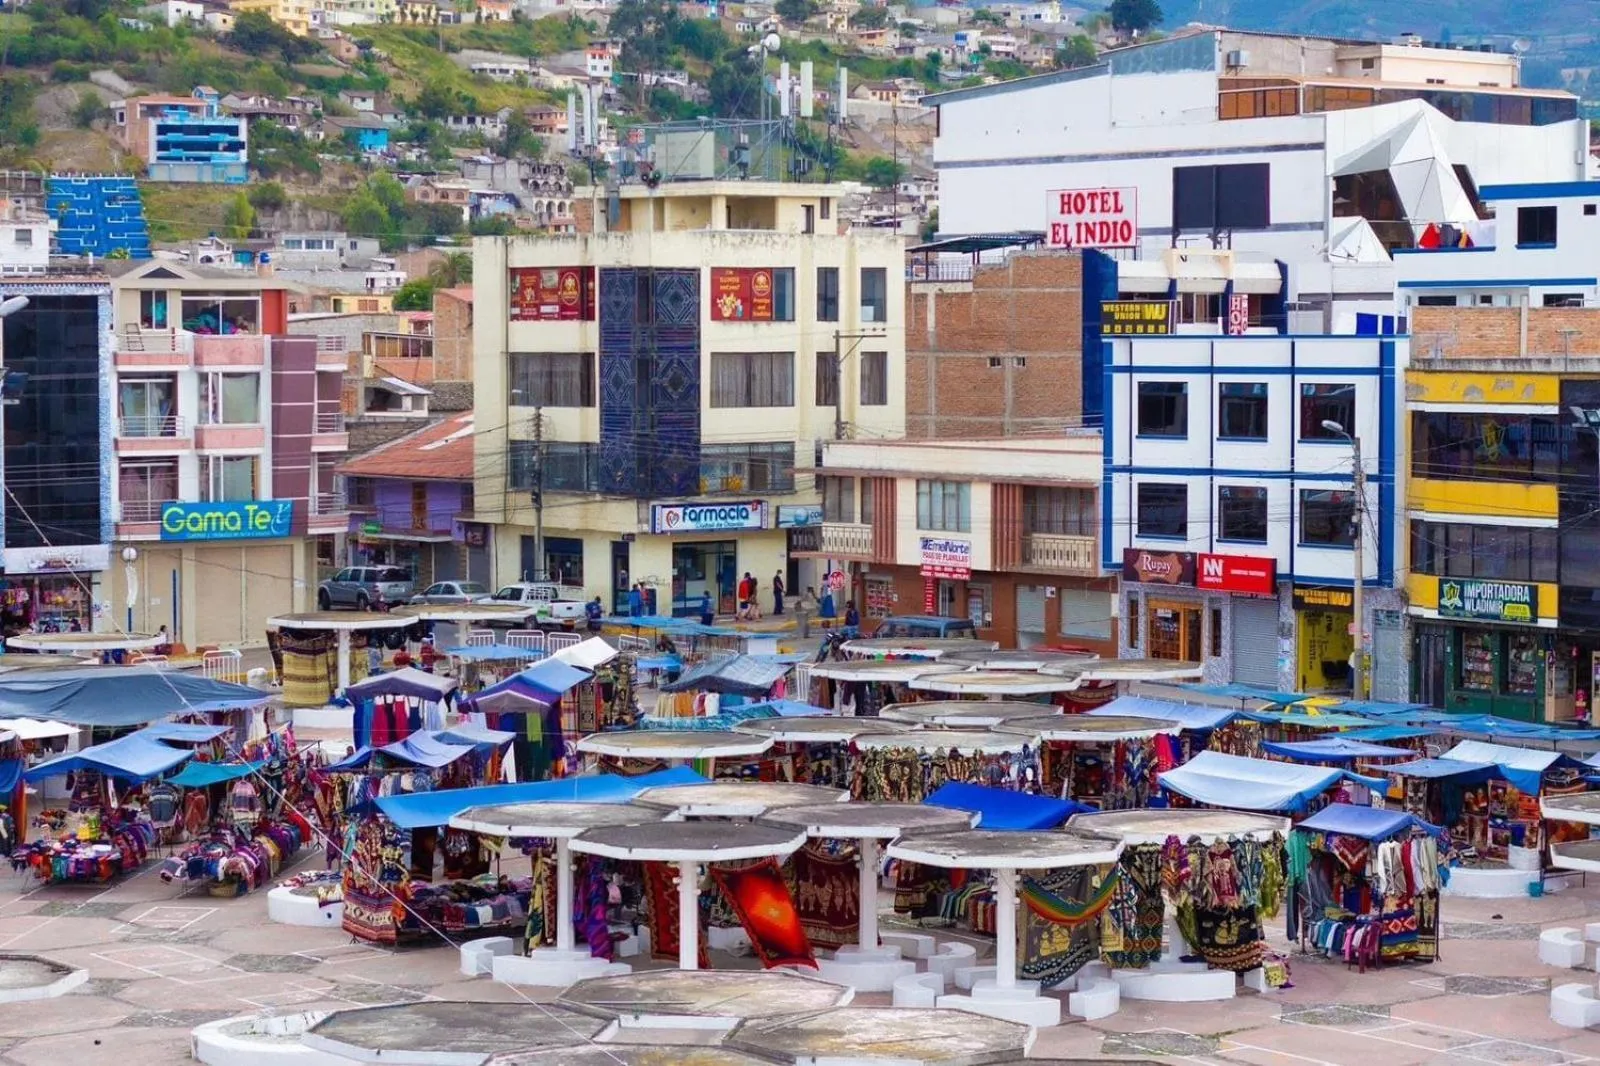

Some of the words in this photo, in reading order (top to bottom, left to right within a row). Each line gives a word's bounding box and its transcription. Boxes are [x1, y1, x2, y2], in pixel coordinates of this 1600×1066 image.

[1060, 191, 1123, 215] HOTEL
[1051, 223, 1072, 245] EL
[1076, 220, 1132, 244] INDIO
[1103, 303, 1141, 312] WESTERN
[1114, 312, 1141, 320] UNION
[163, 506, 241, 533] Gama
[1142, 555, 1172, 574] Rupay
[1464, 582, 1530, 602] IMPORTADORA
[1464, 598, 1504, 615] WLADIMIR
